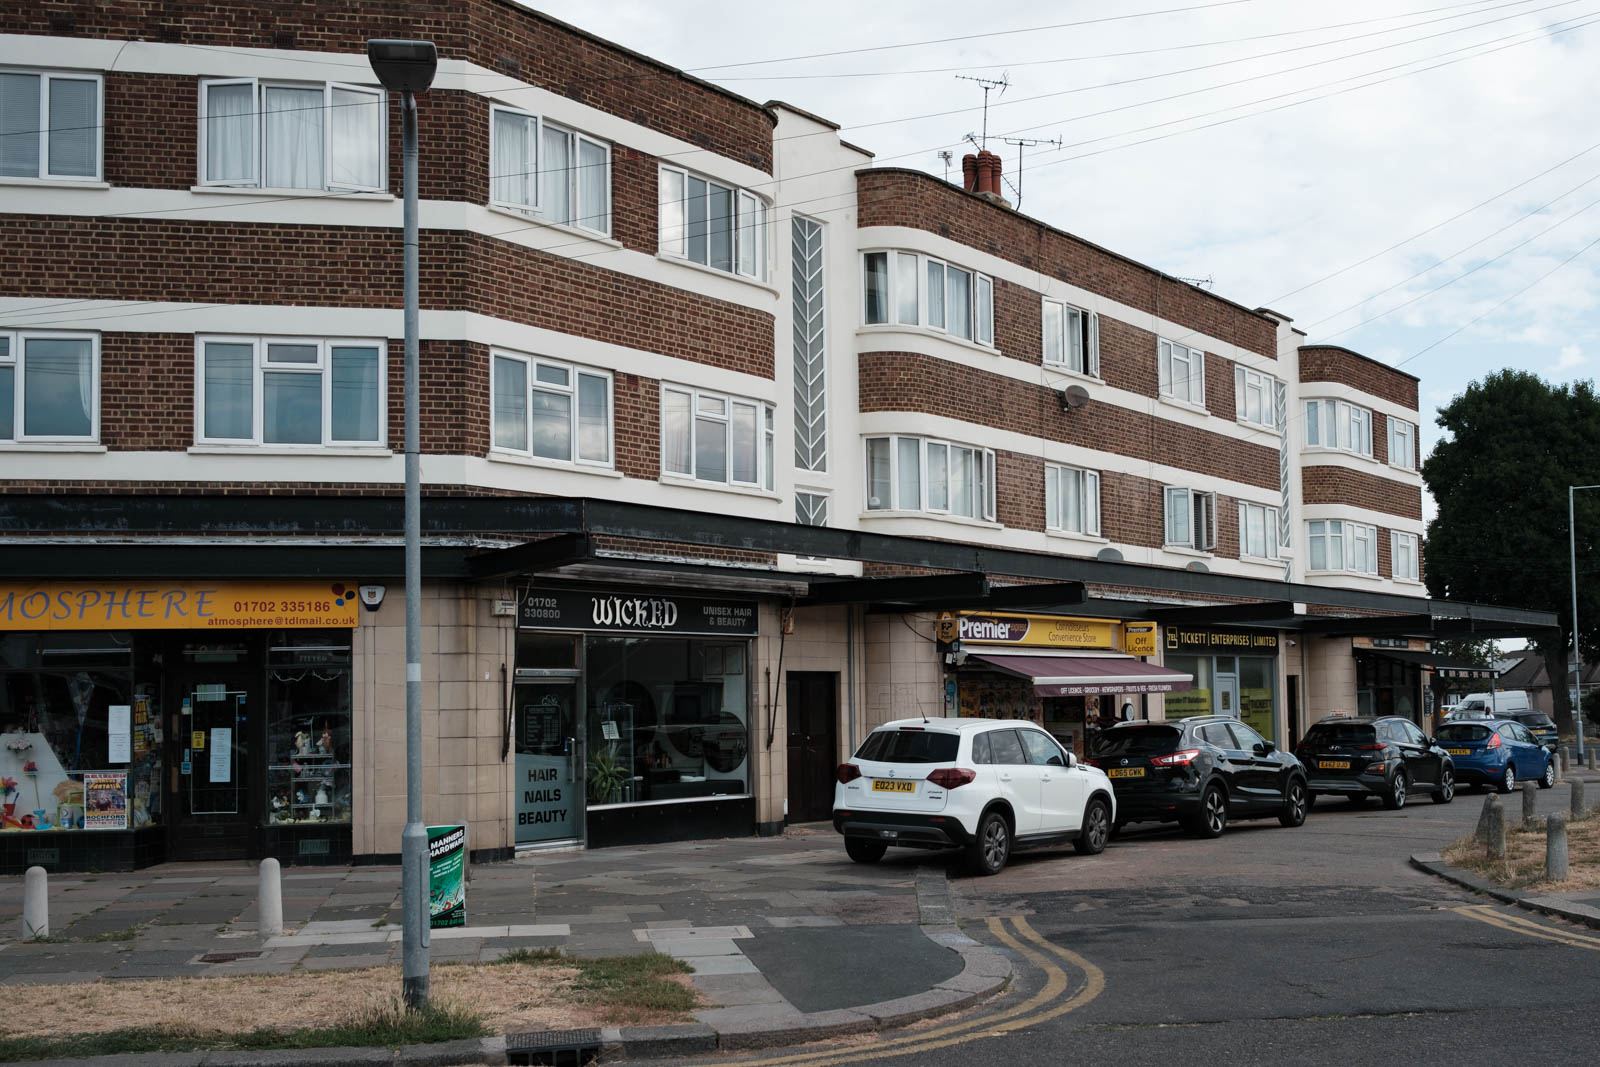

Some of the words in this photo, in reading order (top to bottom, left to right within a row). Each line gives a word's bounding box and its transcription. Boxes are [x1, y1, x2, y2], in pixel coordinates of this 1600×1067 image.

[233, 600, 276, 613] 01702
[281, 600, 331, 613] 335186
[527, 597, 557, 608] 01702
[524, 608, 561, 619] 330800
[591, 596, 678, 629] WICKED
[703, 605, 732, 617] UNISEX
[734, 608, 752, 617] HAIR
[207, 615, 356, 628] atmosphere@tdlmail.co.uk
[709, 618, 715, 626] &
[717, 617, 746, 628] BEAUTY
[959, 617, 1011, 639] Premier
[1048, 631, 1081, 643] Convenience
[1083, 633, 1097, 643] Store
[1135, 637, 1147, 646] Off
[1180, 631, 1207, 645] TICKETT
[1211, 633, 1250, 647] ENTERPRISES
[1253, 635, 1277, 648] LIMITED
[1127, 645, 1154, 653] Licence
[528, 767, 558, 783] HAIR
[524, 788, 562, 804] NAILS
[518, 808, 567, 826] BEAUTY
[430, 830, 464, 849] MANNERS
[430, 837, 464, 857] HARDWARE
